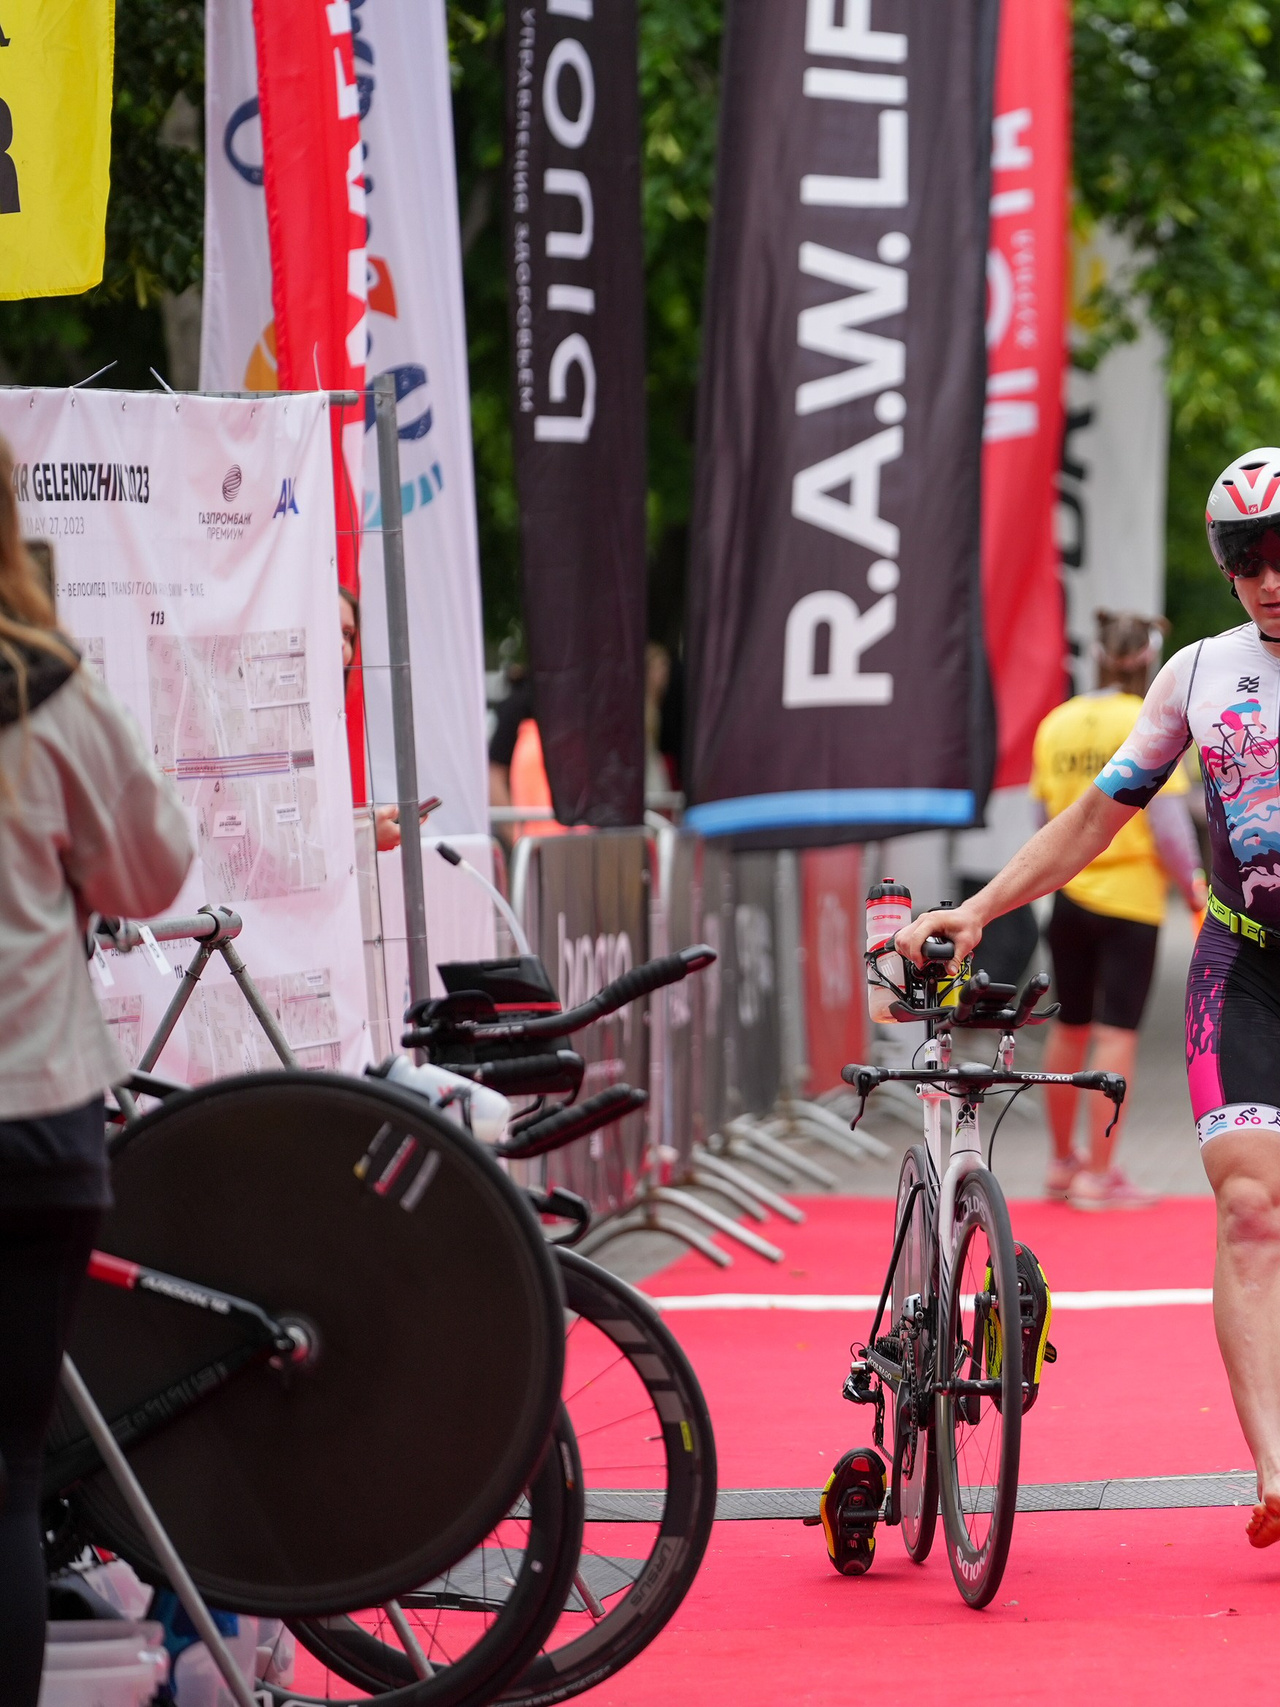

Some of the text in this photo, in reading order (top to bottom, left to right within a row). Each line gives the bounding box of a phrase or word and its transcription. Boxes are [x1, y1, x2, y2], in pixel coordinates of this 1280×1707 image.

[32, 462, 126, 503] GELENDZHIK
[198, 512, 252, 525] ГАЗПРОМБАНК
[49, 517, 61, 538] 27,
[64, 516, 85, 535] 2023
[207, 526, 244, 540] ПРЕМИУМ
[67, 582, 107, 598] ВЕЛОСИПЕД
[111, 581, 158, 596] TRANSITION
[150, 611, 165, 625] 113
[870, 1360, 892, 1381] COLNAGO
